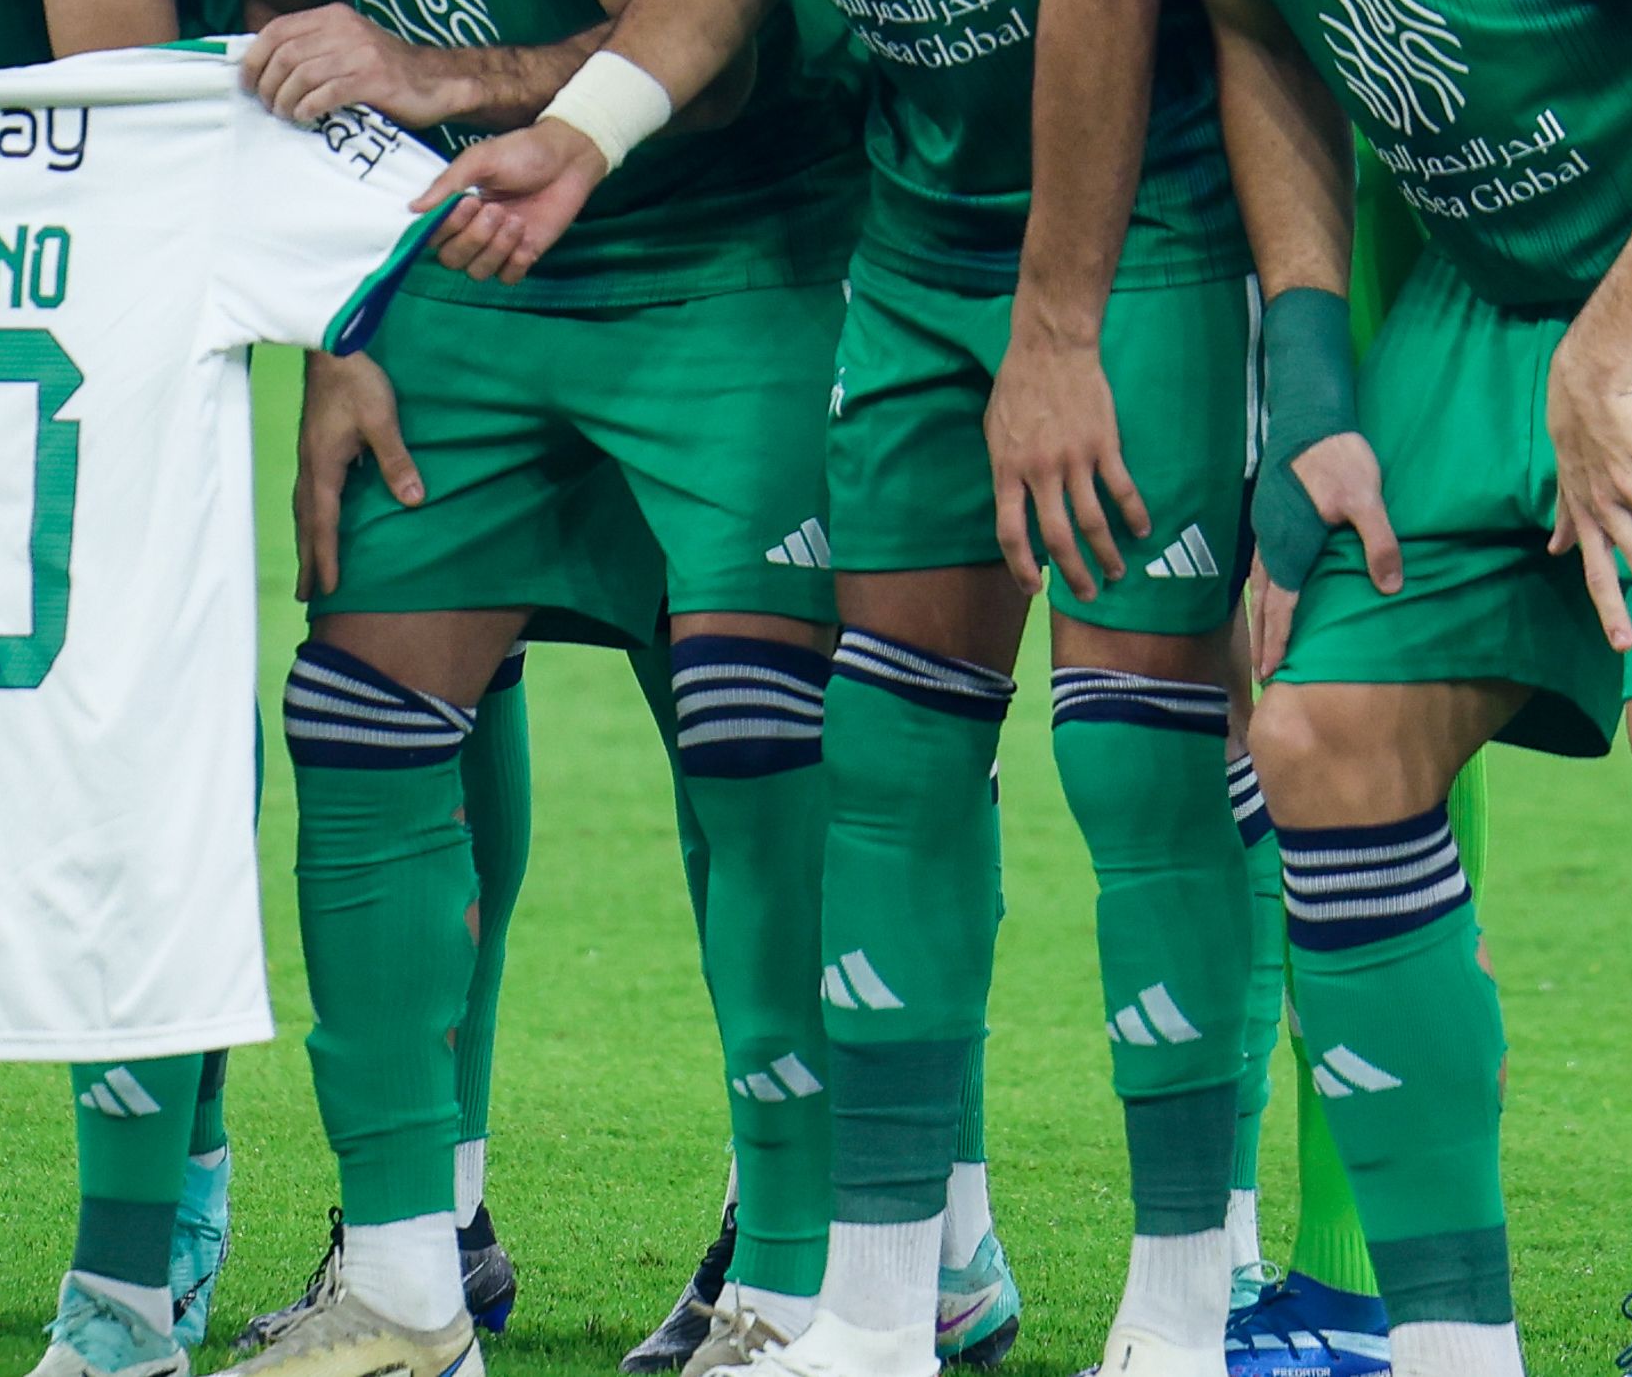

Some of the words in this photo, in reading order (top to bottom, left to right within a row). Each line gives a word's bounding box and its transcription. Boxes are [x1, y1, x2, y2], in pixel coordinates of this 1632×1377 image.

[916, 6, 1030, 69] Global
[1501, 108, 1566, 168] البحر
[1415, 186, 1469, 219] Sea
[1470, 148, 1590, 213] Global
